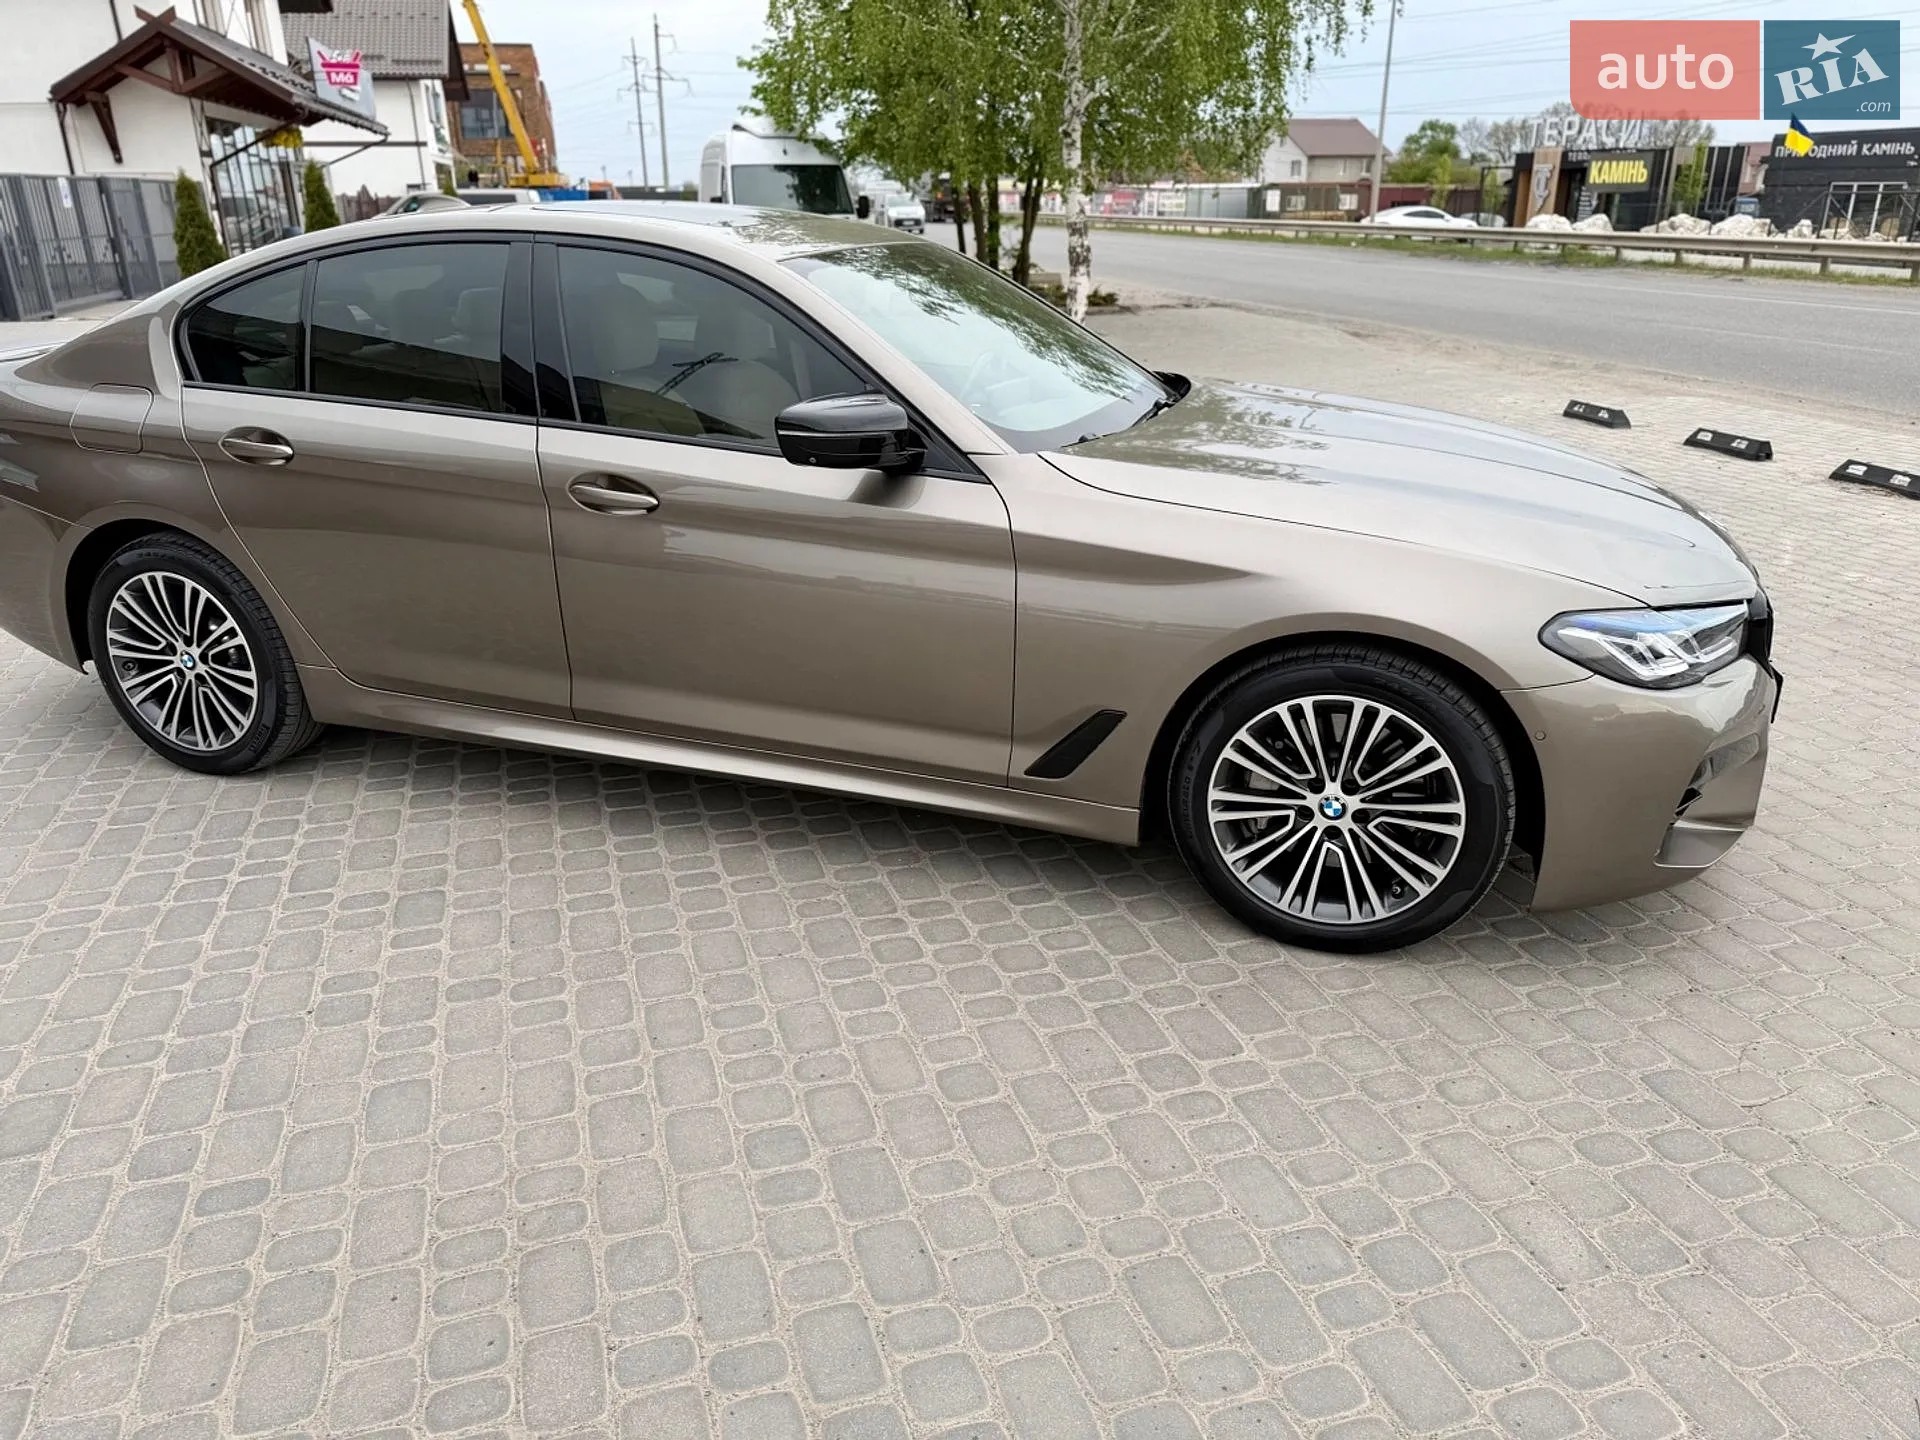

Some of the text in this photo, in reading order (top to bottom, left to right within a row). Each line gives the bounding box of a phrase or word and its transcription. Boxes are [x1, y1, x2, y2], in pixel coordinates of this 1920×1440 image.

[1774, 140, 1915, 159] ПРОДНИЙ КАМІНЬ
[1589, 160, 1648, 184] КАМІНЬ
